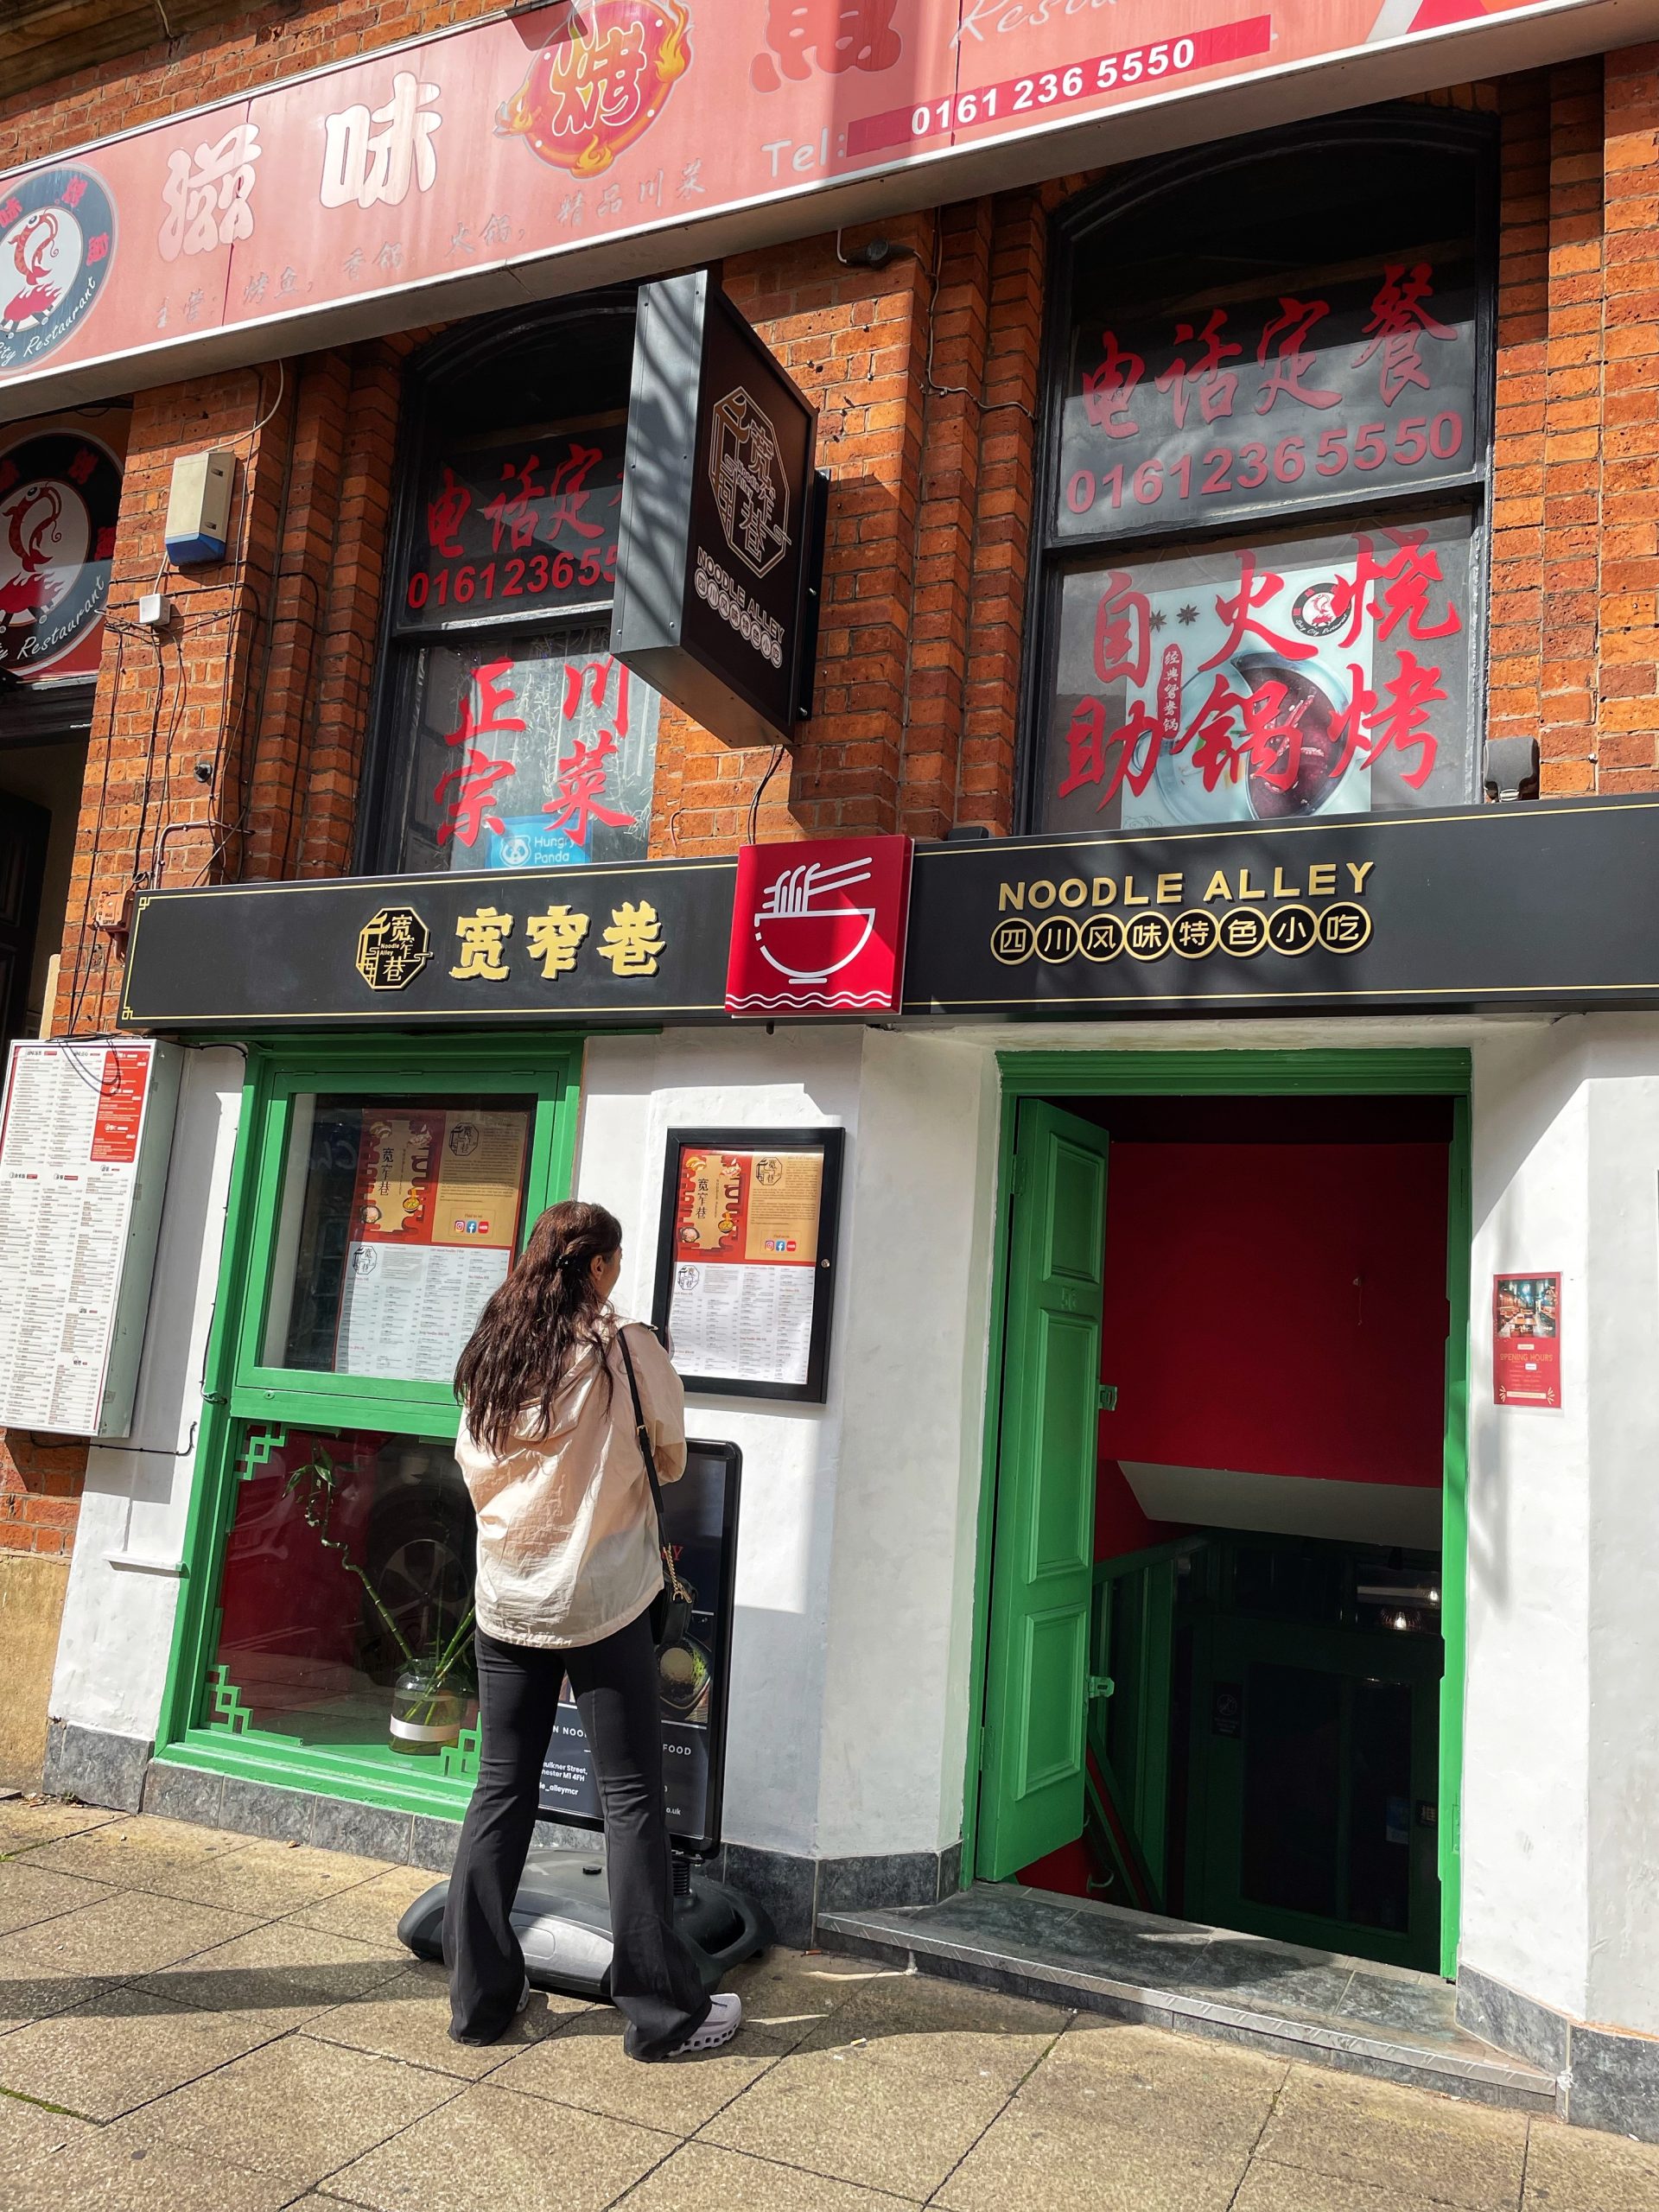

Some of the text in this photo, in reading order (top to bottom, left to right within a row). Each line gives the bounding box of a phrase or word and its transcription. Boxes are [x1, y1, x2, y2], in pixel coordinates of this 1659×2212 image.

[761, 38, 1195, 178] Tel: 0161 236 5550
[23, 276, 95, 358] Restaurant
[1083, 263, 1458, 439] 电话定餐
[428, 442, 622, 558] 电话定
[1066, 410, 1463, 514] 01612365550
[17, 575, 105, 659] Restaurant
[697, 546, 785, 644] NOODLE ALLEY
[535, 836, 575, 849] Hungry
[535, 850, 569, 864] Panda
[998, 861, 1374, 912] NOODLE ALLEY
[448, 899, 665, 981] 宽窄巷
[994, 907, 1367, 960] 四川风味特色小吃
[663, 1744, 691, 1755] FOOD
